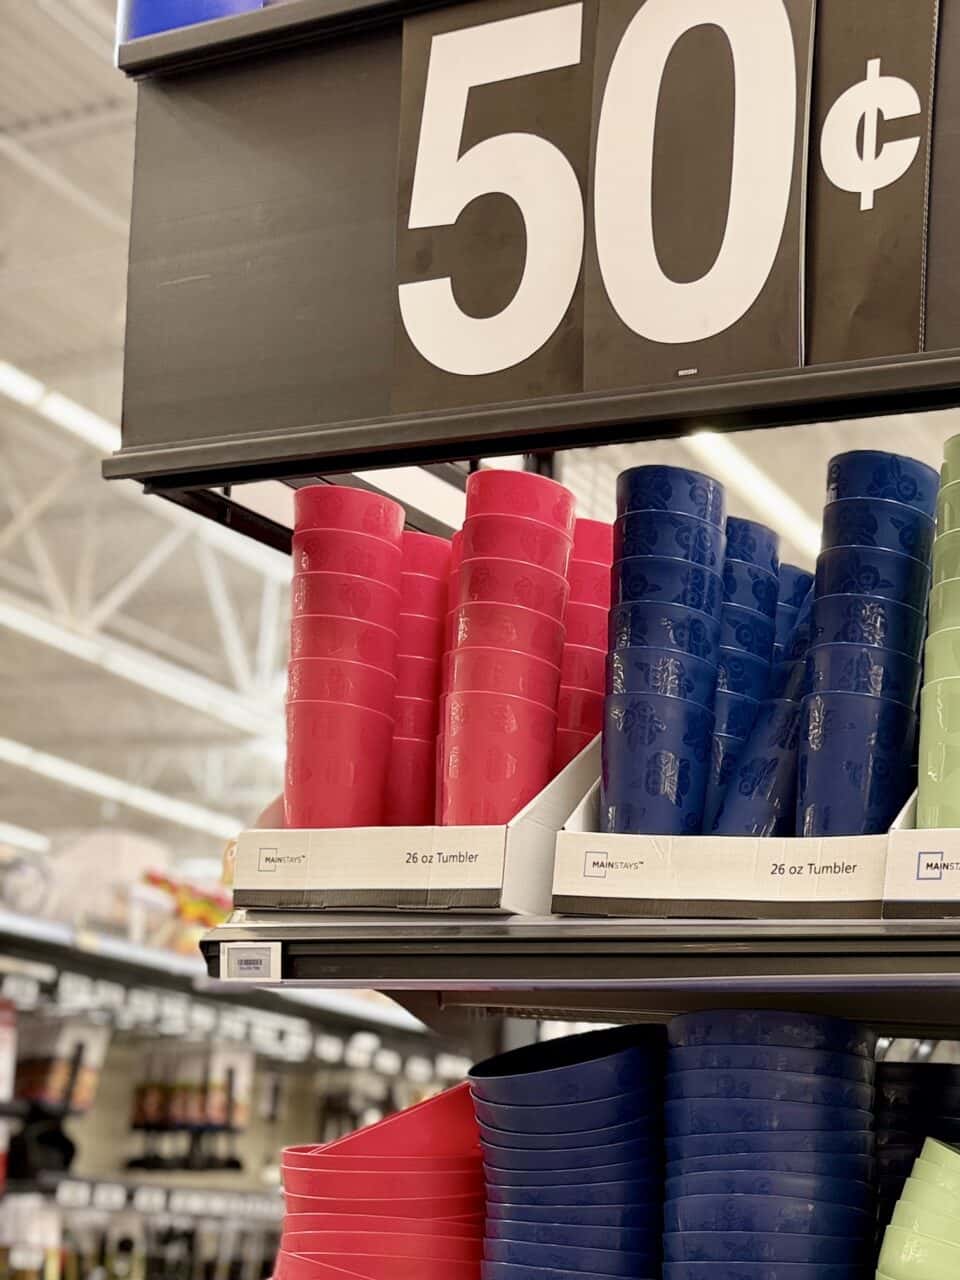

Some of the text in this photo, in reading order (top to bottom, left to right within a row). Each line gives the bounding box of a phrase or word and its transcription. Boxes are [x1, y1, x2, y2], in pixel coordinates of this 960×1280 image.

[397, 0, 921, 375] 50¢
[405, 852, 478, 864] 26 oz Tumbler
[771, 862, 857, 875] 26 oz Tumbler
